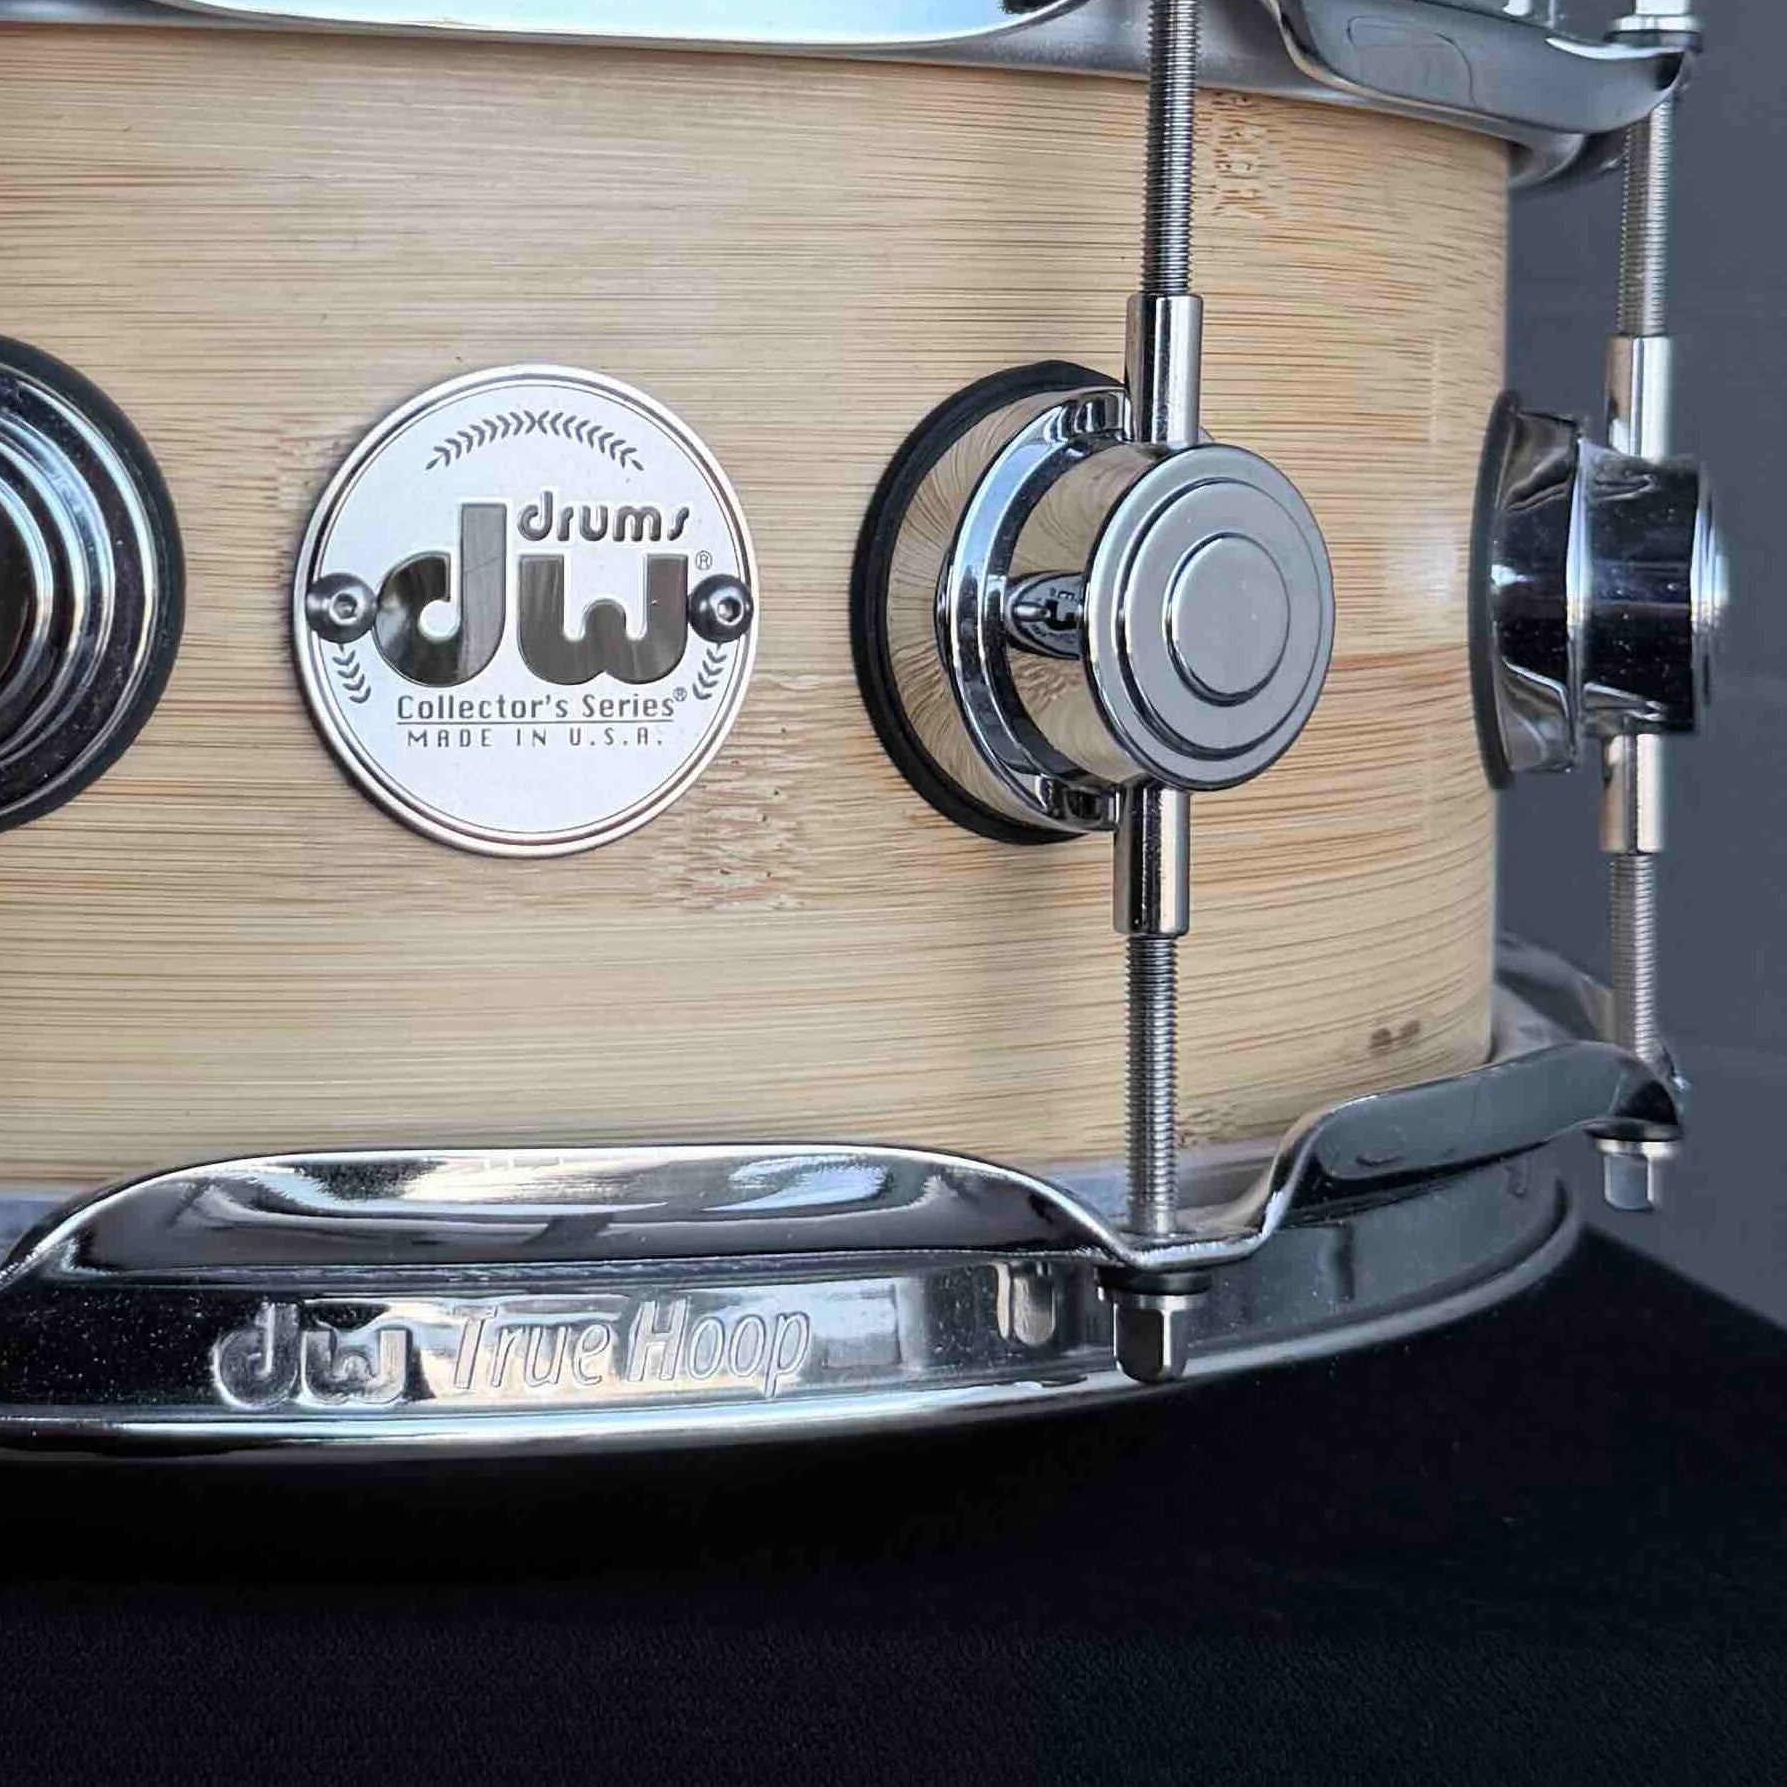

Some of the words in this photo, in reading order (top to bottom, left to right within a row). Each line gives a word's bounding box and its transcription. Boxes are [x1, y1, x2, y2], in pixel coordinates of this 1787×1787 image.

[518, 491, 690, 542] drums
[397, 695, 567, 719] Collector's
[408, 729, 492, 747] MADE
[517, 729, 546, 746] IN
[569, 728, 663, 746] U.S.A.
[453, 1306, 608, 1389] True
[628, 1299, 812, 1397] Hoop
